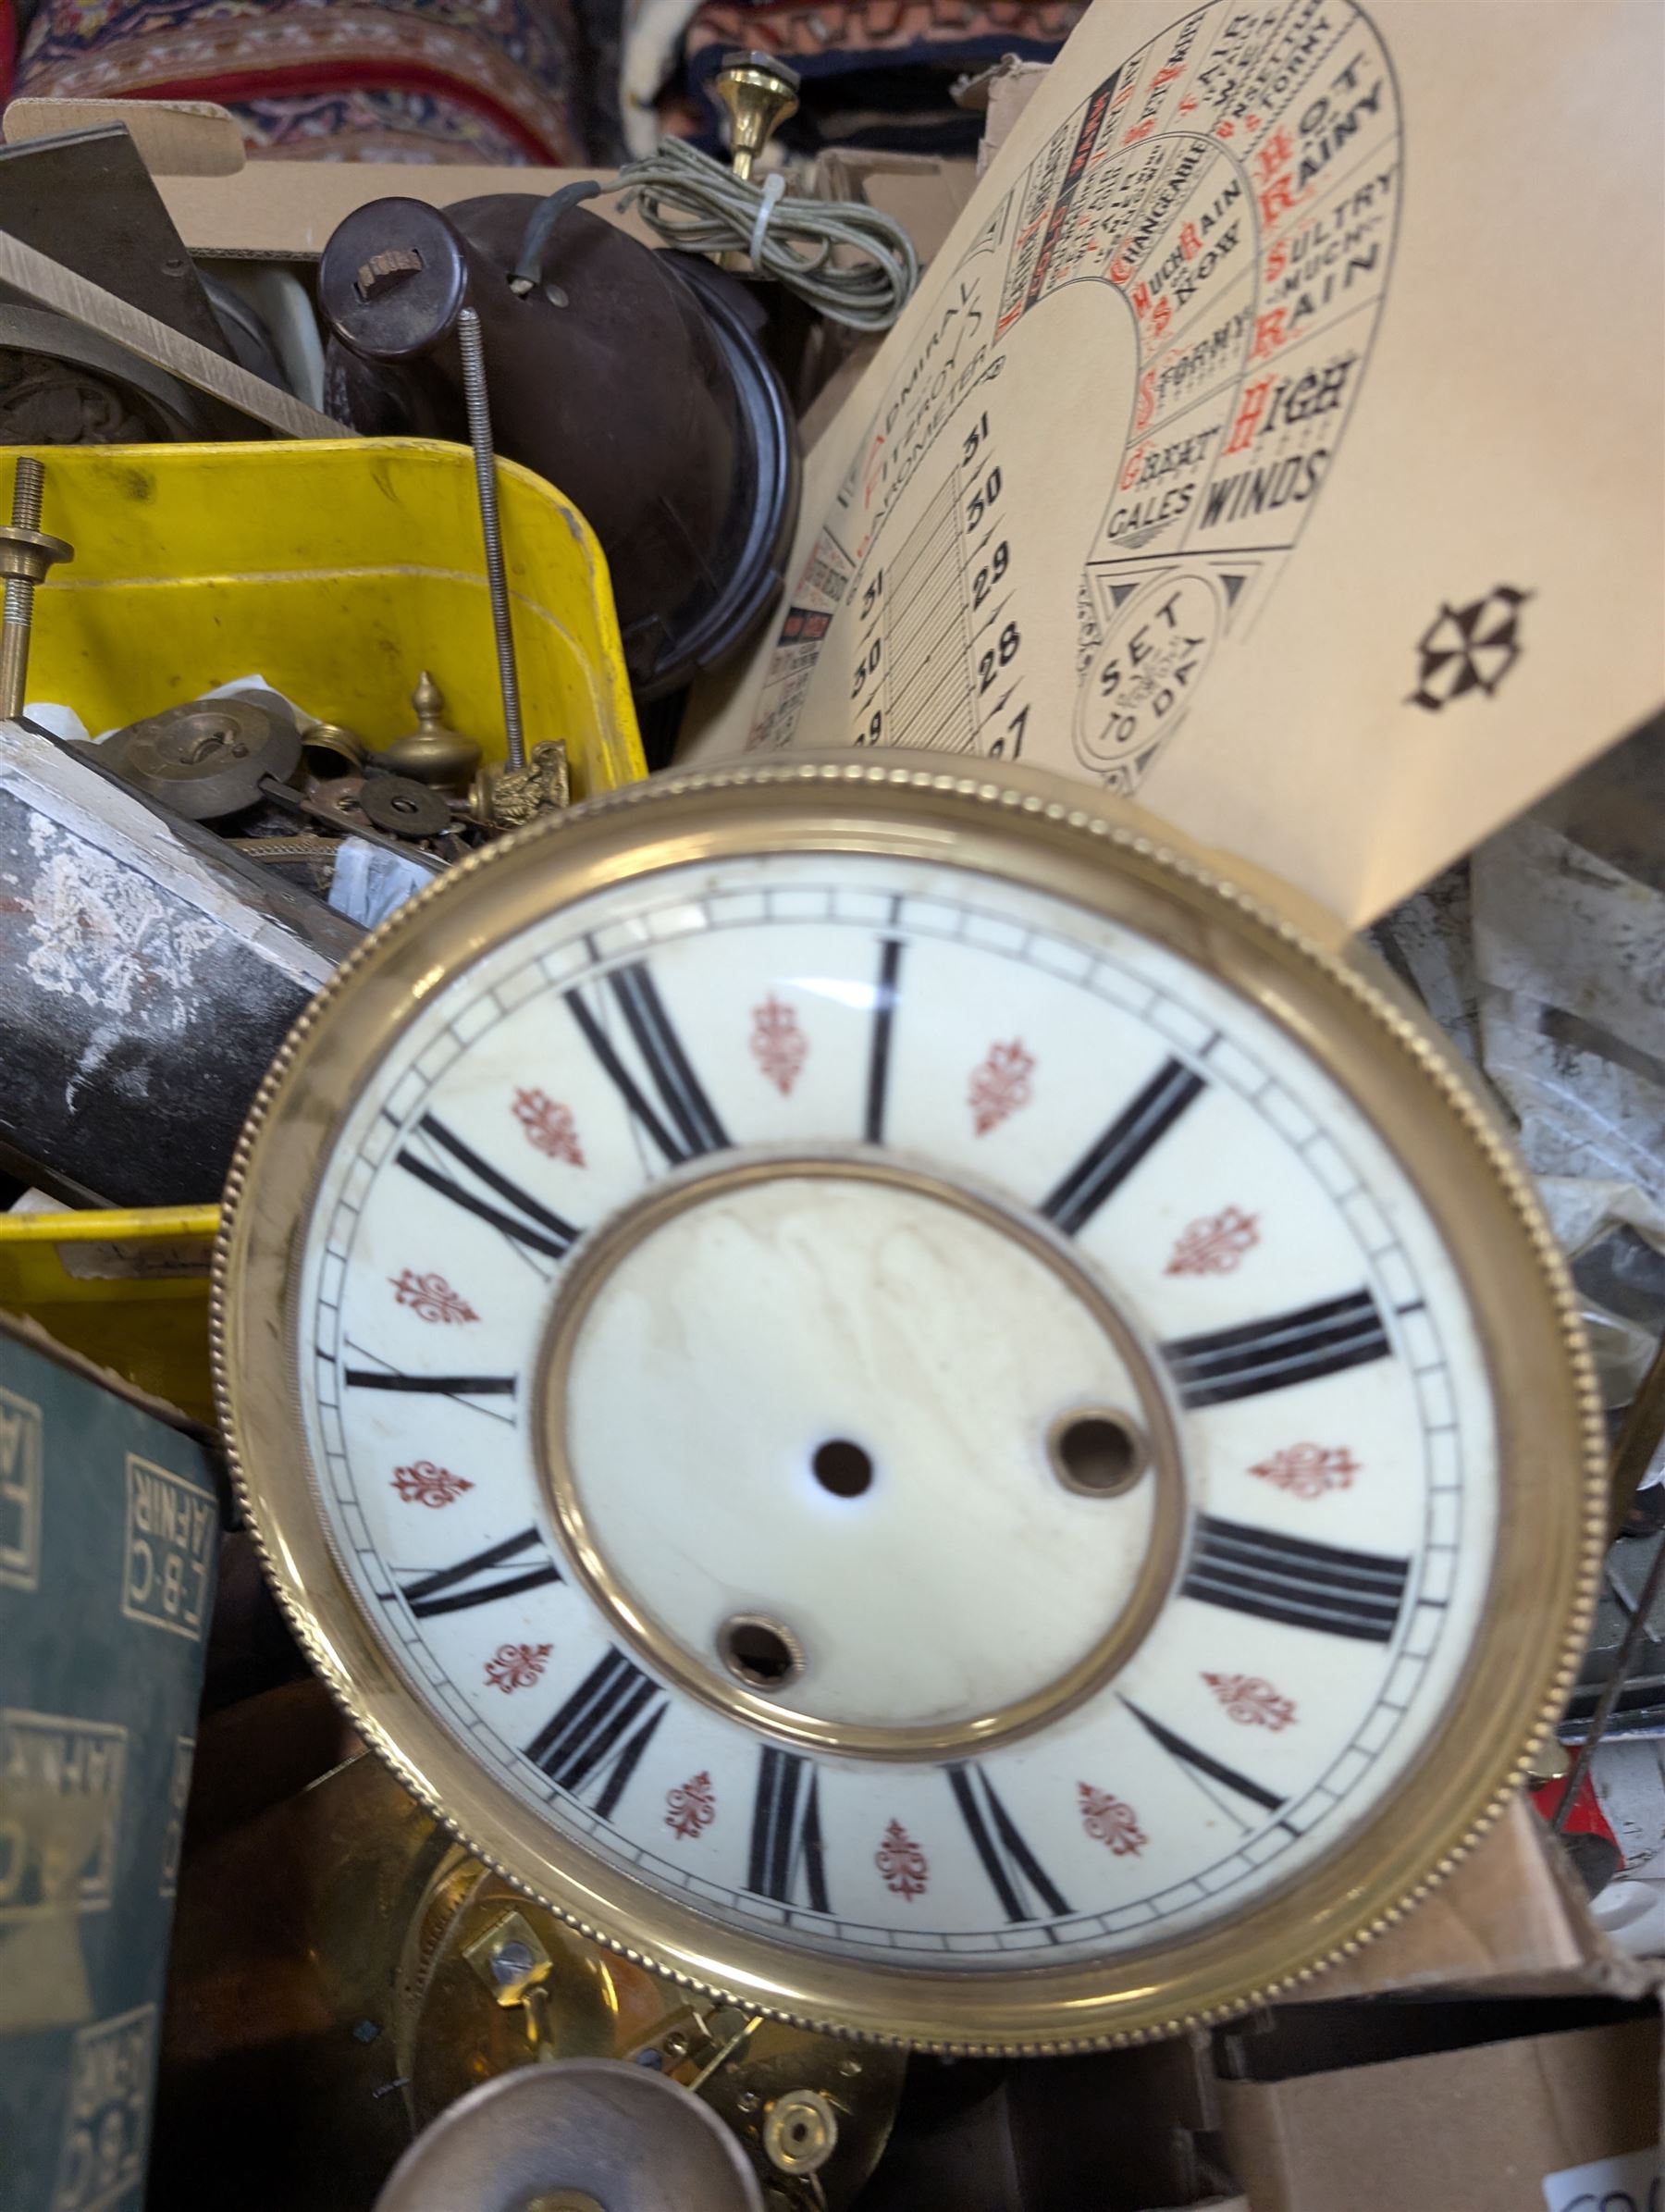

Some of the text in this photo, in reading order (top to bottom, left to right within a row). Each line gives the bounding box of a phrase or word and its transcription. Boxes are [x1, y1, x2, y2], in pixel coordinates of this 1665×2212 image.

[1245, 17, 1331, 132] STORMY
[1255, 52, 1366, 182] HOT
[1257, 80, 1386, 229] RAINY
[1110, 141, 1208, 286] CHANGEABLE
[1264, 167, 1394, 282] SULTRY
[1252, 242, 1381, 360] RAIN
[963, 410, 989, 468] 31
[1223, 355, 1356, 455] HIGH
[966, 465, 1002, 535] 30
[1107, 483, 1196, 540] GALES
[1199, 449, 1331, 533] WINDS
[860, 568, 882, 622] 31
[972, 539, 1012, 611] 29
[851, 637, 882, 699] 30
[979, 621, 1022, 698] 28
[1099, 637, 1204, 743] TO DAY
[1102, 590, 1182, 697] SET
[562, 957, 736, 1181] XII
[865, 939, 908, 1144] I
[395, 1106, 589, 1282] XI
[1039, 1055, 1209, 1238] II
[343, 1333, 516, 1427] X
[1157, 1286, 1394, 1412] III
[389, 1526, 567, 1617] IX
[1180, 1512, 1411, 1645] IIII
[519, 1641, 671, 1823] VIII
[1115, 1691, 1289, 1838] V
[747, 1744, 835, 1916] VII
[942, 1761, 1076, 1923] VI
